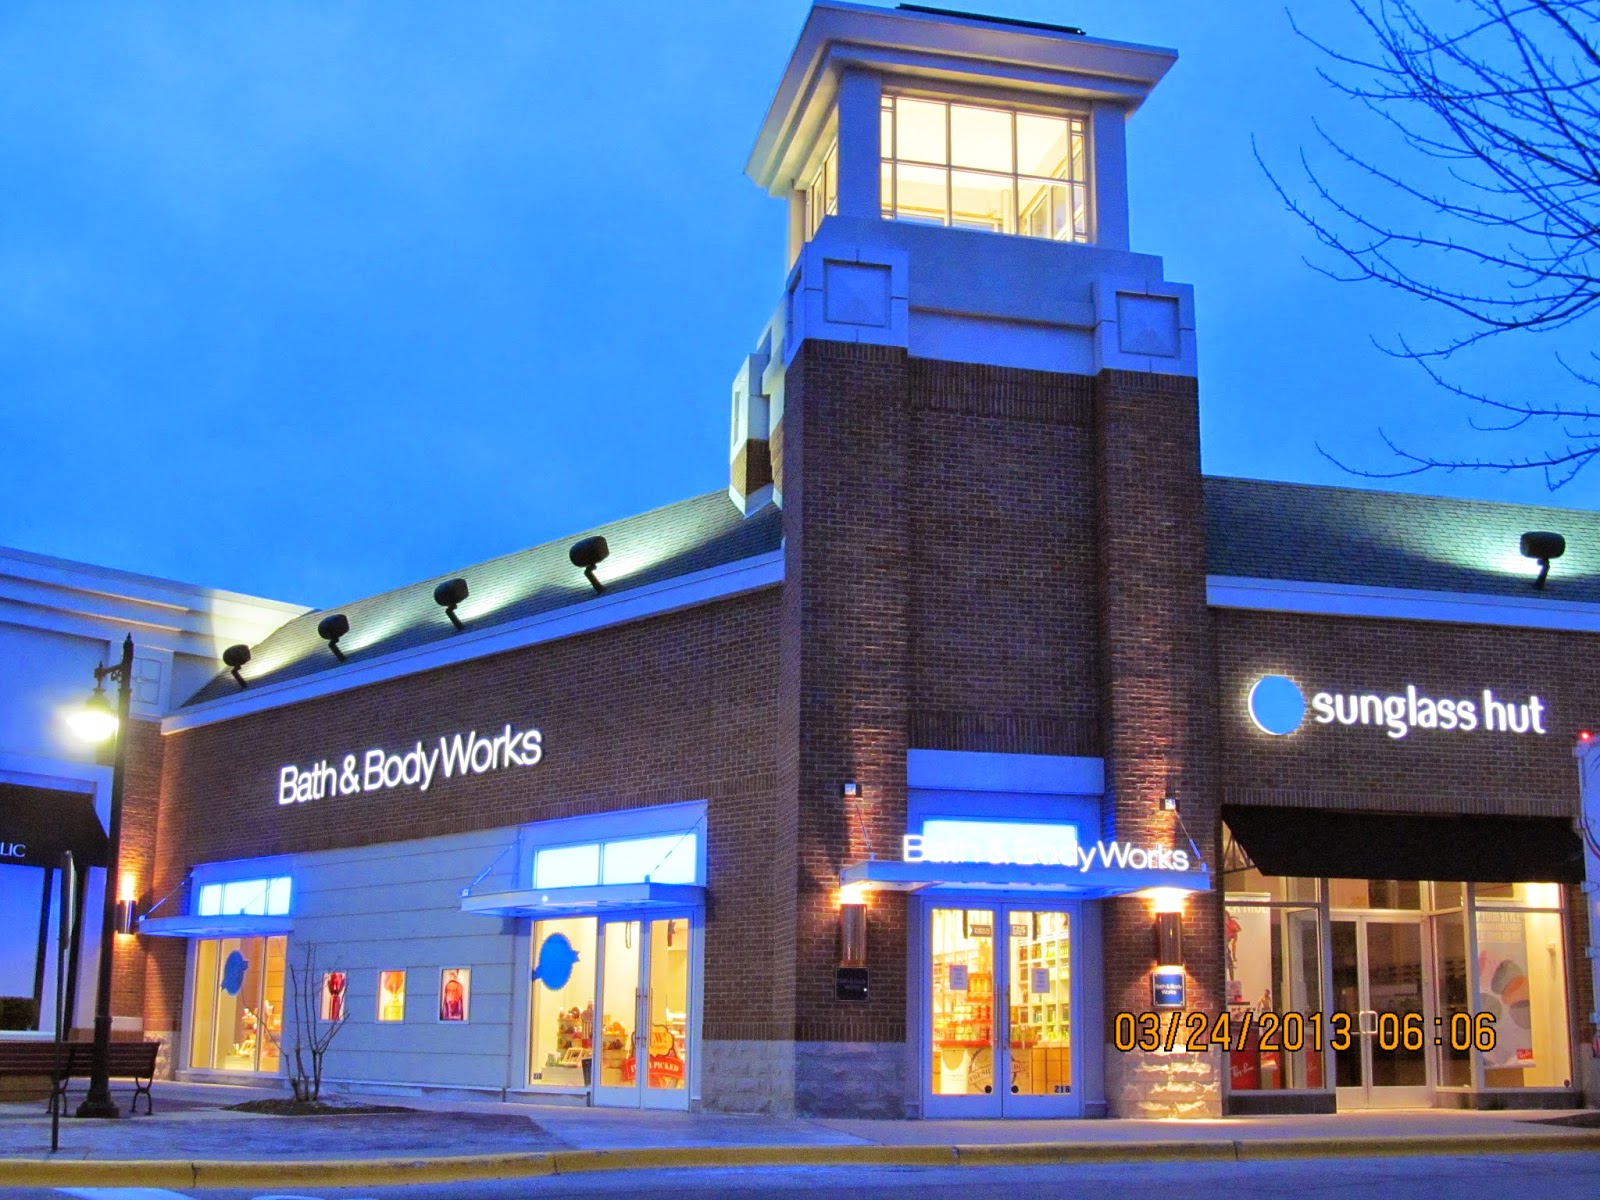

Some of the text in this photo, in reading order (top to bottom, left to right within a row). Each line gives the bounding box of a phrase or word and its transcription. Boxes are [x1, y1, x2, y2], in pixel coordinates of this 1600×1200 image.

[1312, 685, 1546, 738] sunglass hut
[279, 759, 337, 805] Bath
[364, 741, 439, 791] Body
[440, 724, 542, 778] Works
[1097, 840, 1189, 871] Works
